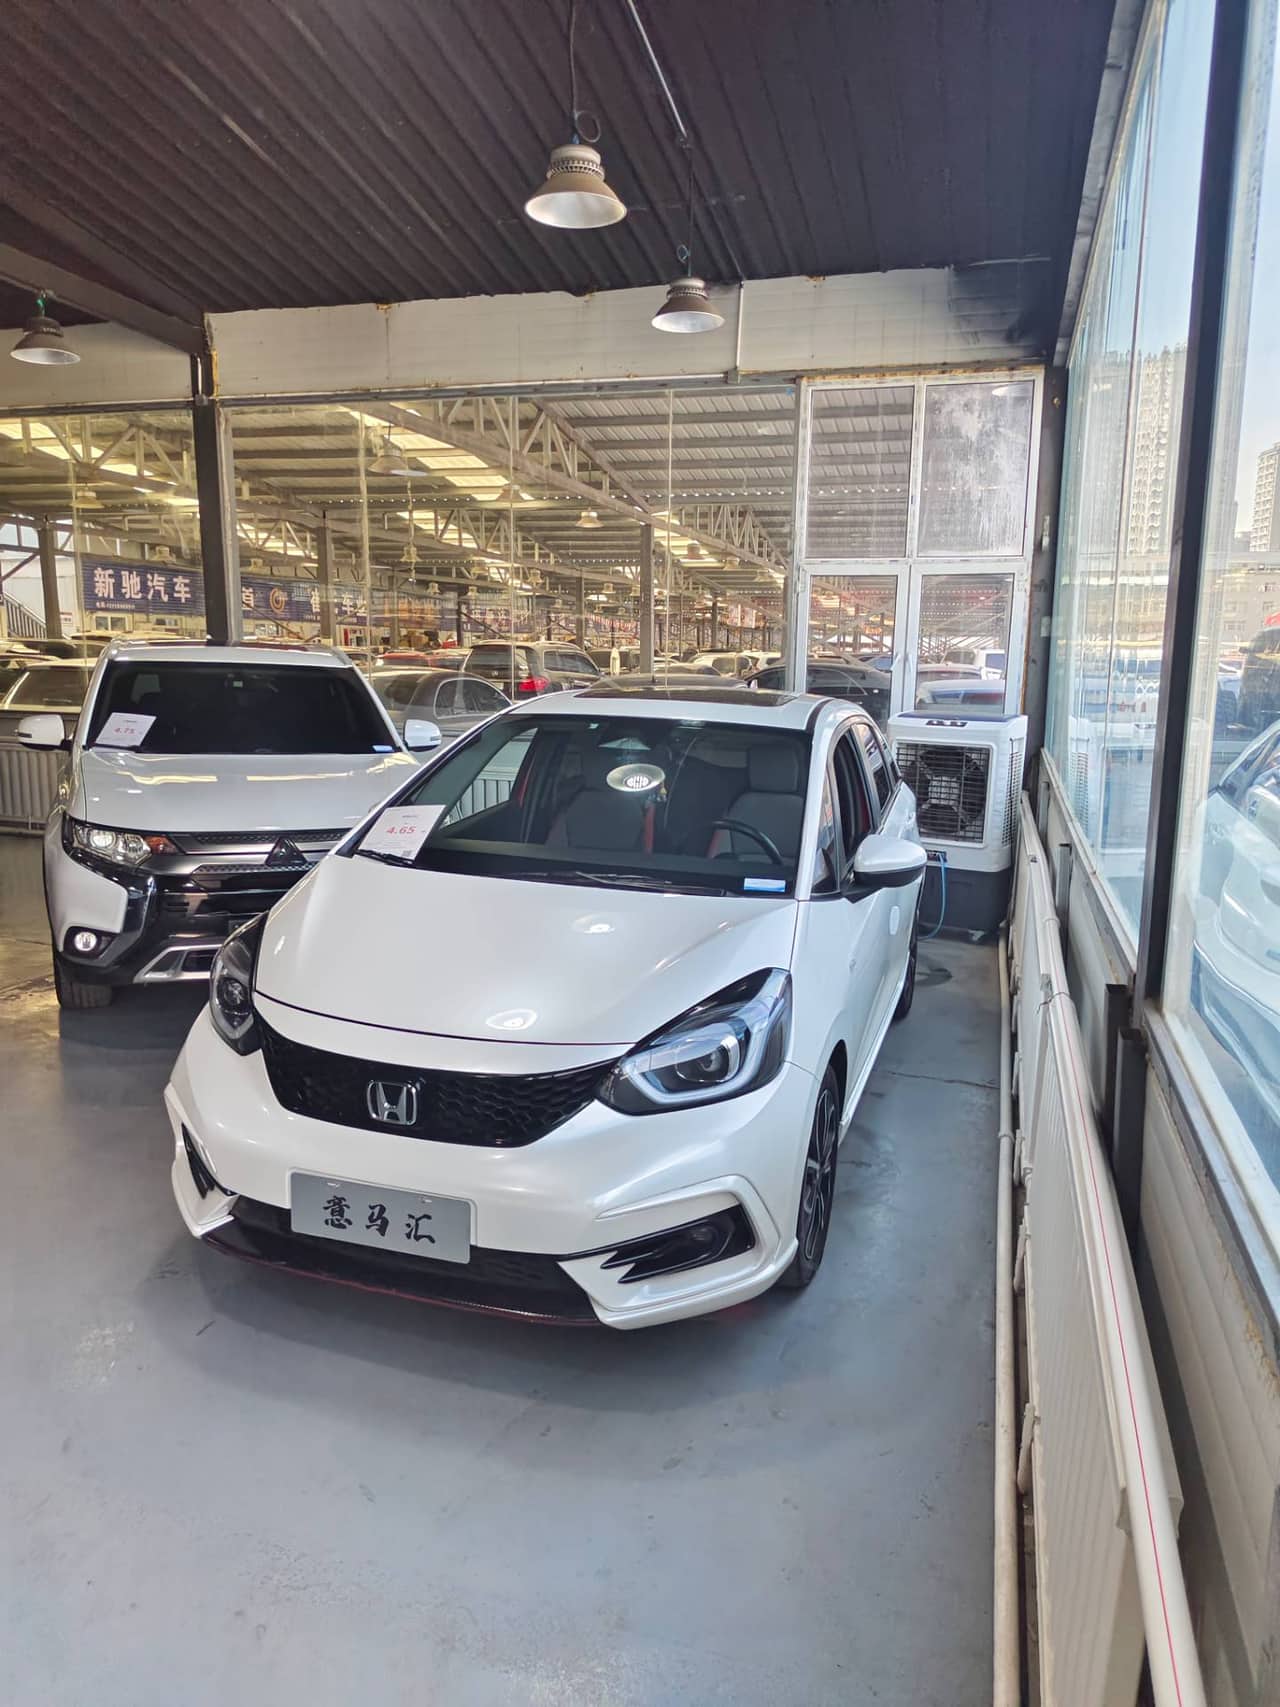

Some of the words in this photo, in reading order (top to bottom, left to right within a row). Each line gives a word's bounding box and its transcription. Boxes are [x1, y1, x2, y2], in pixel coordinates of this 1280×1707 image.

[94, 567, 191, 603] 新驰汽车
[386, 825, 417, 835] 4.65
[322, 1195, 437, 1245] 意马汇
